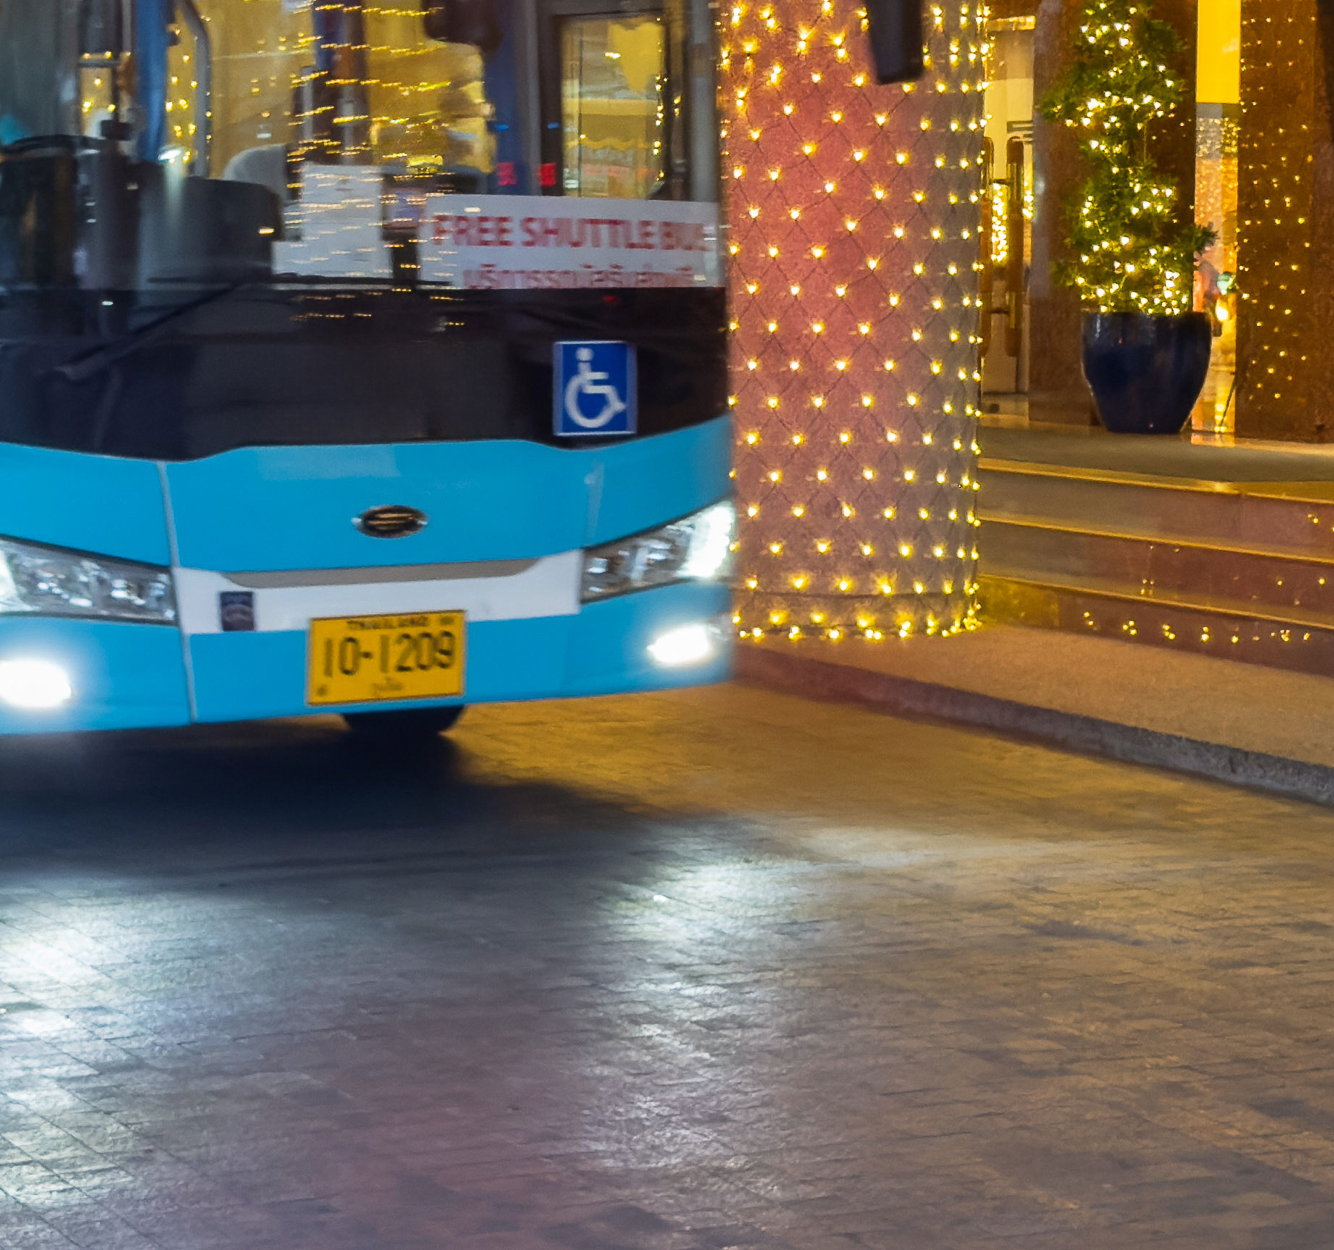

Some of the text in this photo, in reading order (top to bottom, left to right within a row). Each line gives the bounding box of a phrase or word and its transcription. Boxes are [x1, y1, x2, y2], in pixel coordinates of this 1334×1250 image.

[435, 215, 513, 247] FREE
[520, 216, 656, 250] SHUTTLE
[323, 630, 456, 677] 10-1209
